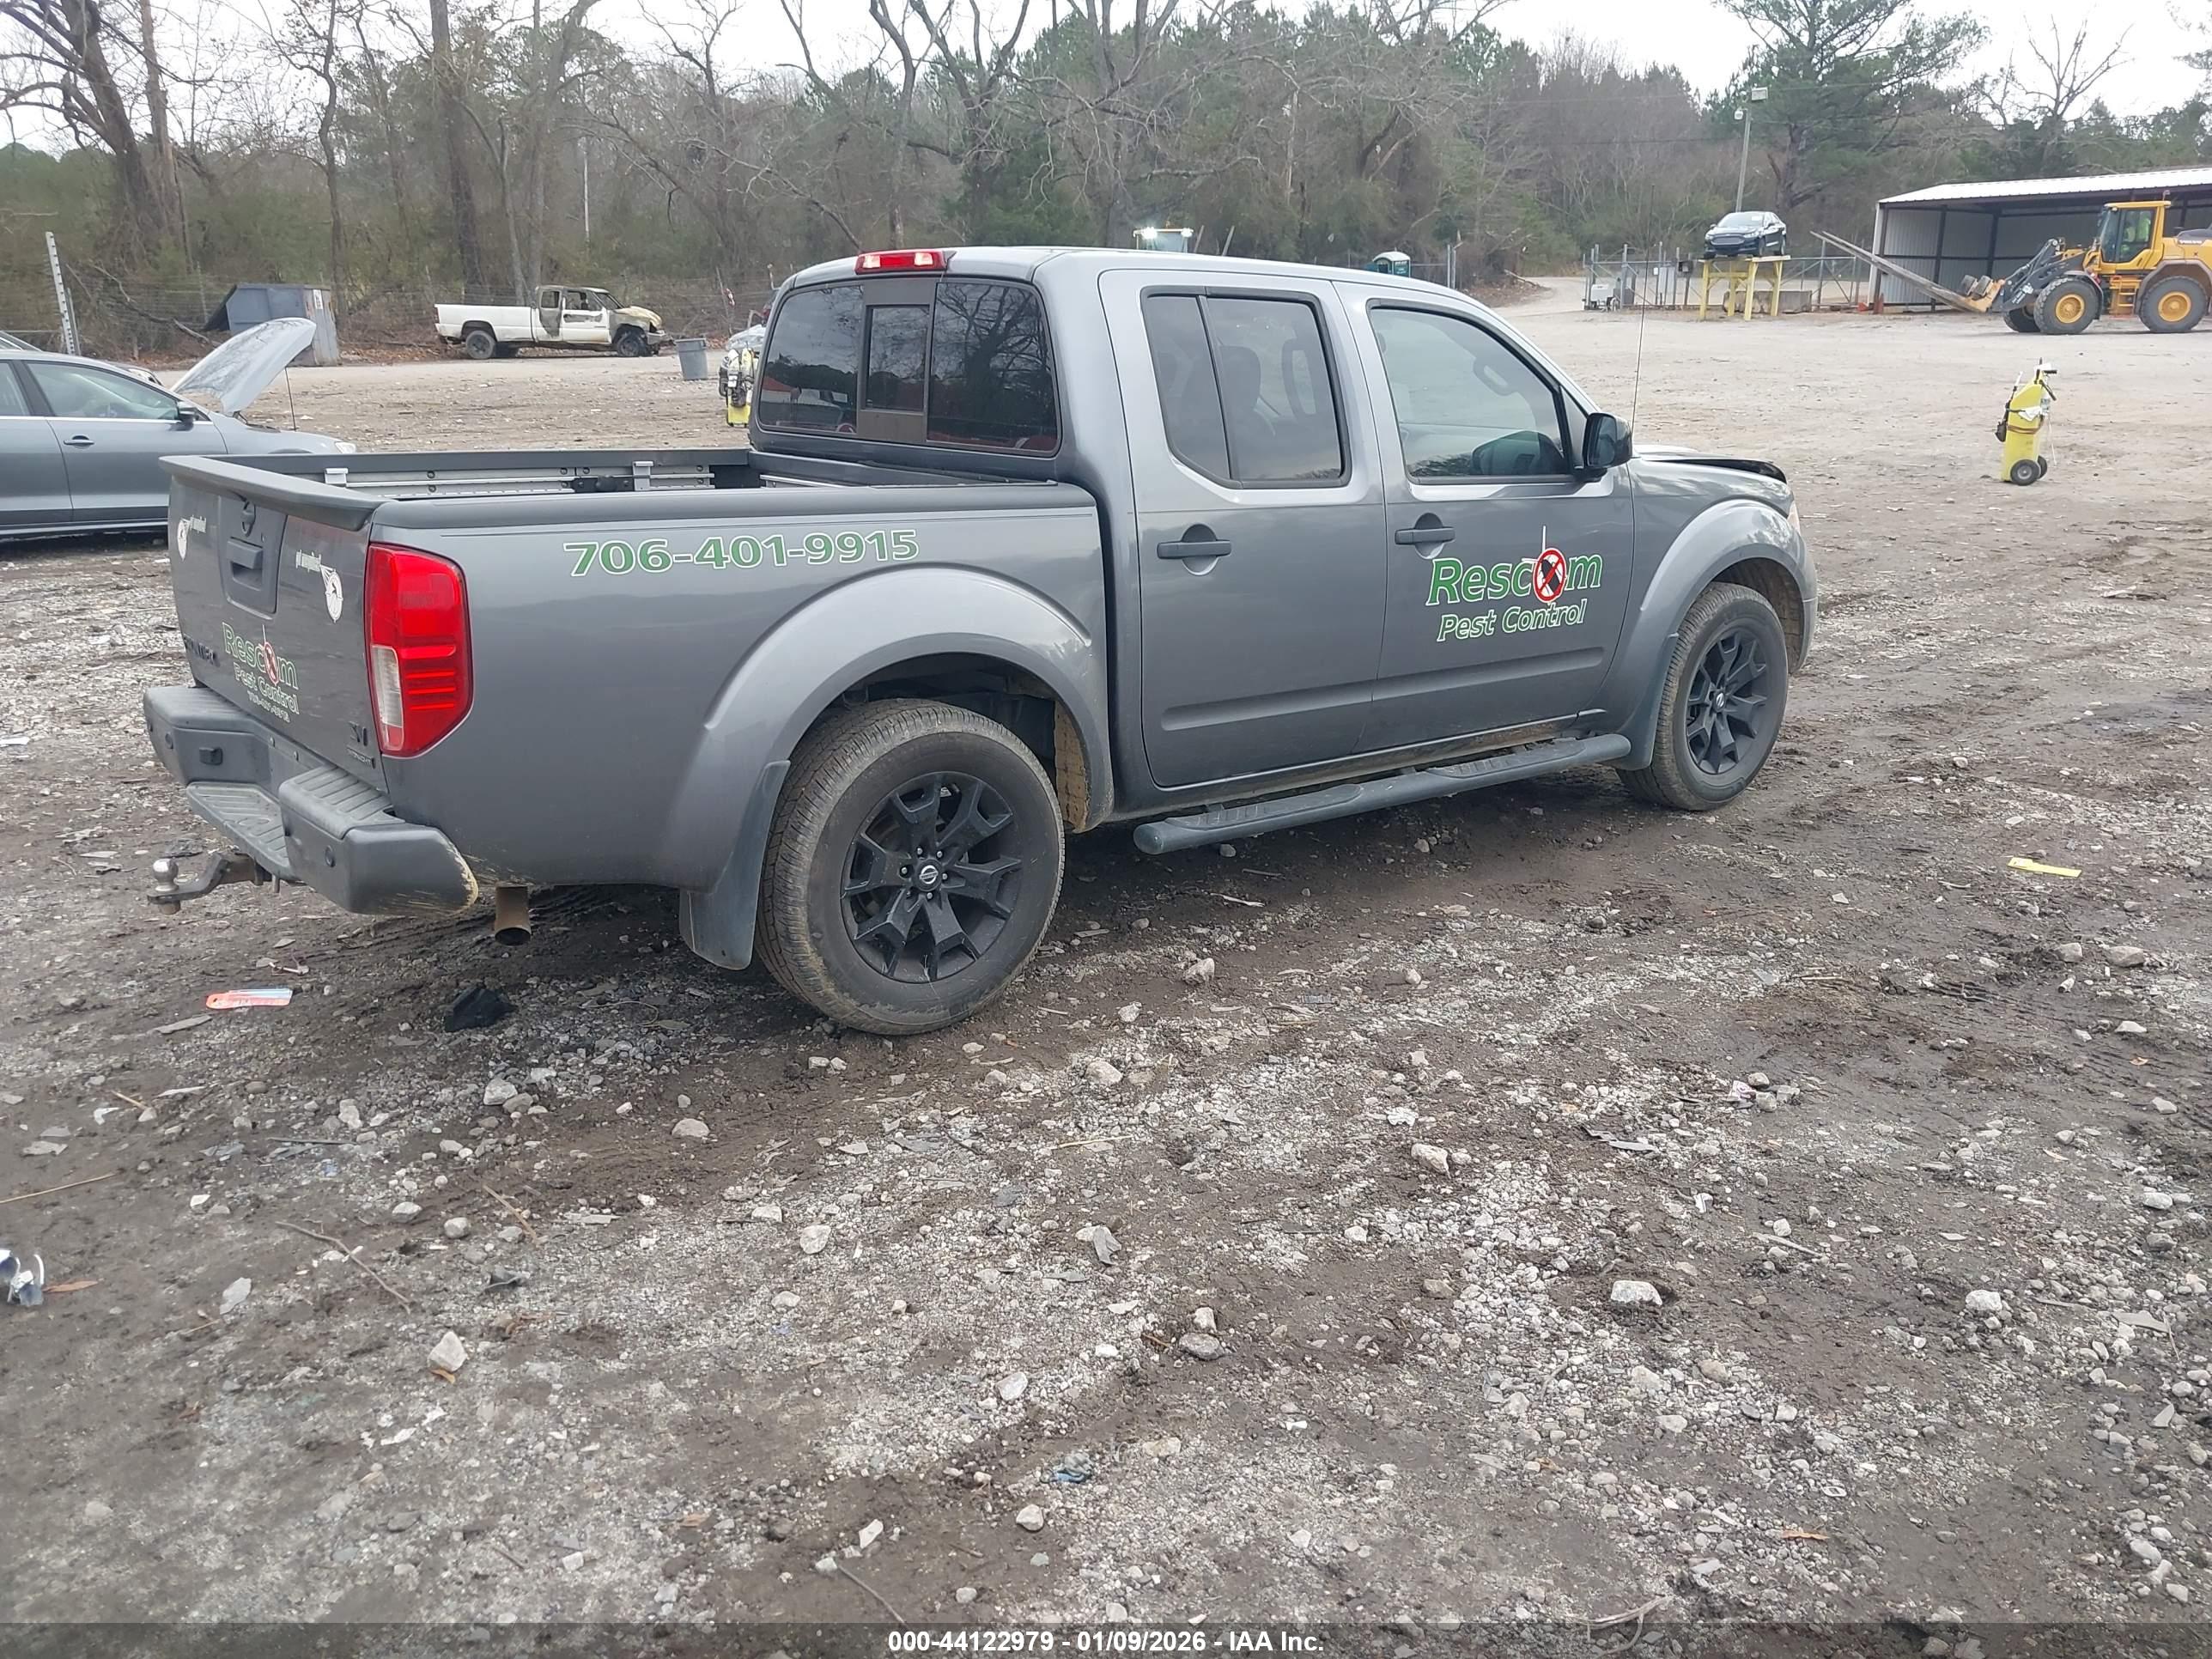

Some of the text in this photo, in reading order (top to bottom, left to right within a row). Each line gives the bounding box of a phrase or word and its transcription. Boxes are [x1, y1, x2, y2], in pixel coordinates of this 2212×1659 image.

[563, 529, 919, 577] 706-401-9915
[1437, 599, 1587, 641] Pest Control
[233, 661, 258, 690] Pest
[258, 676, 300, 714] Control
